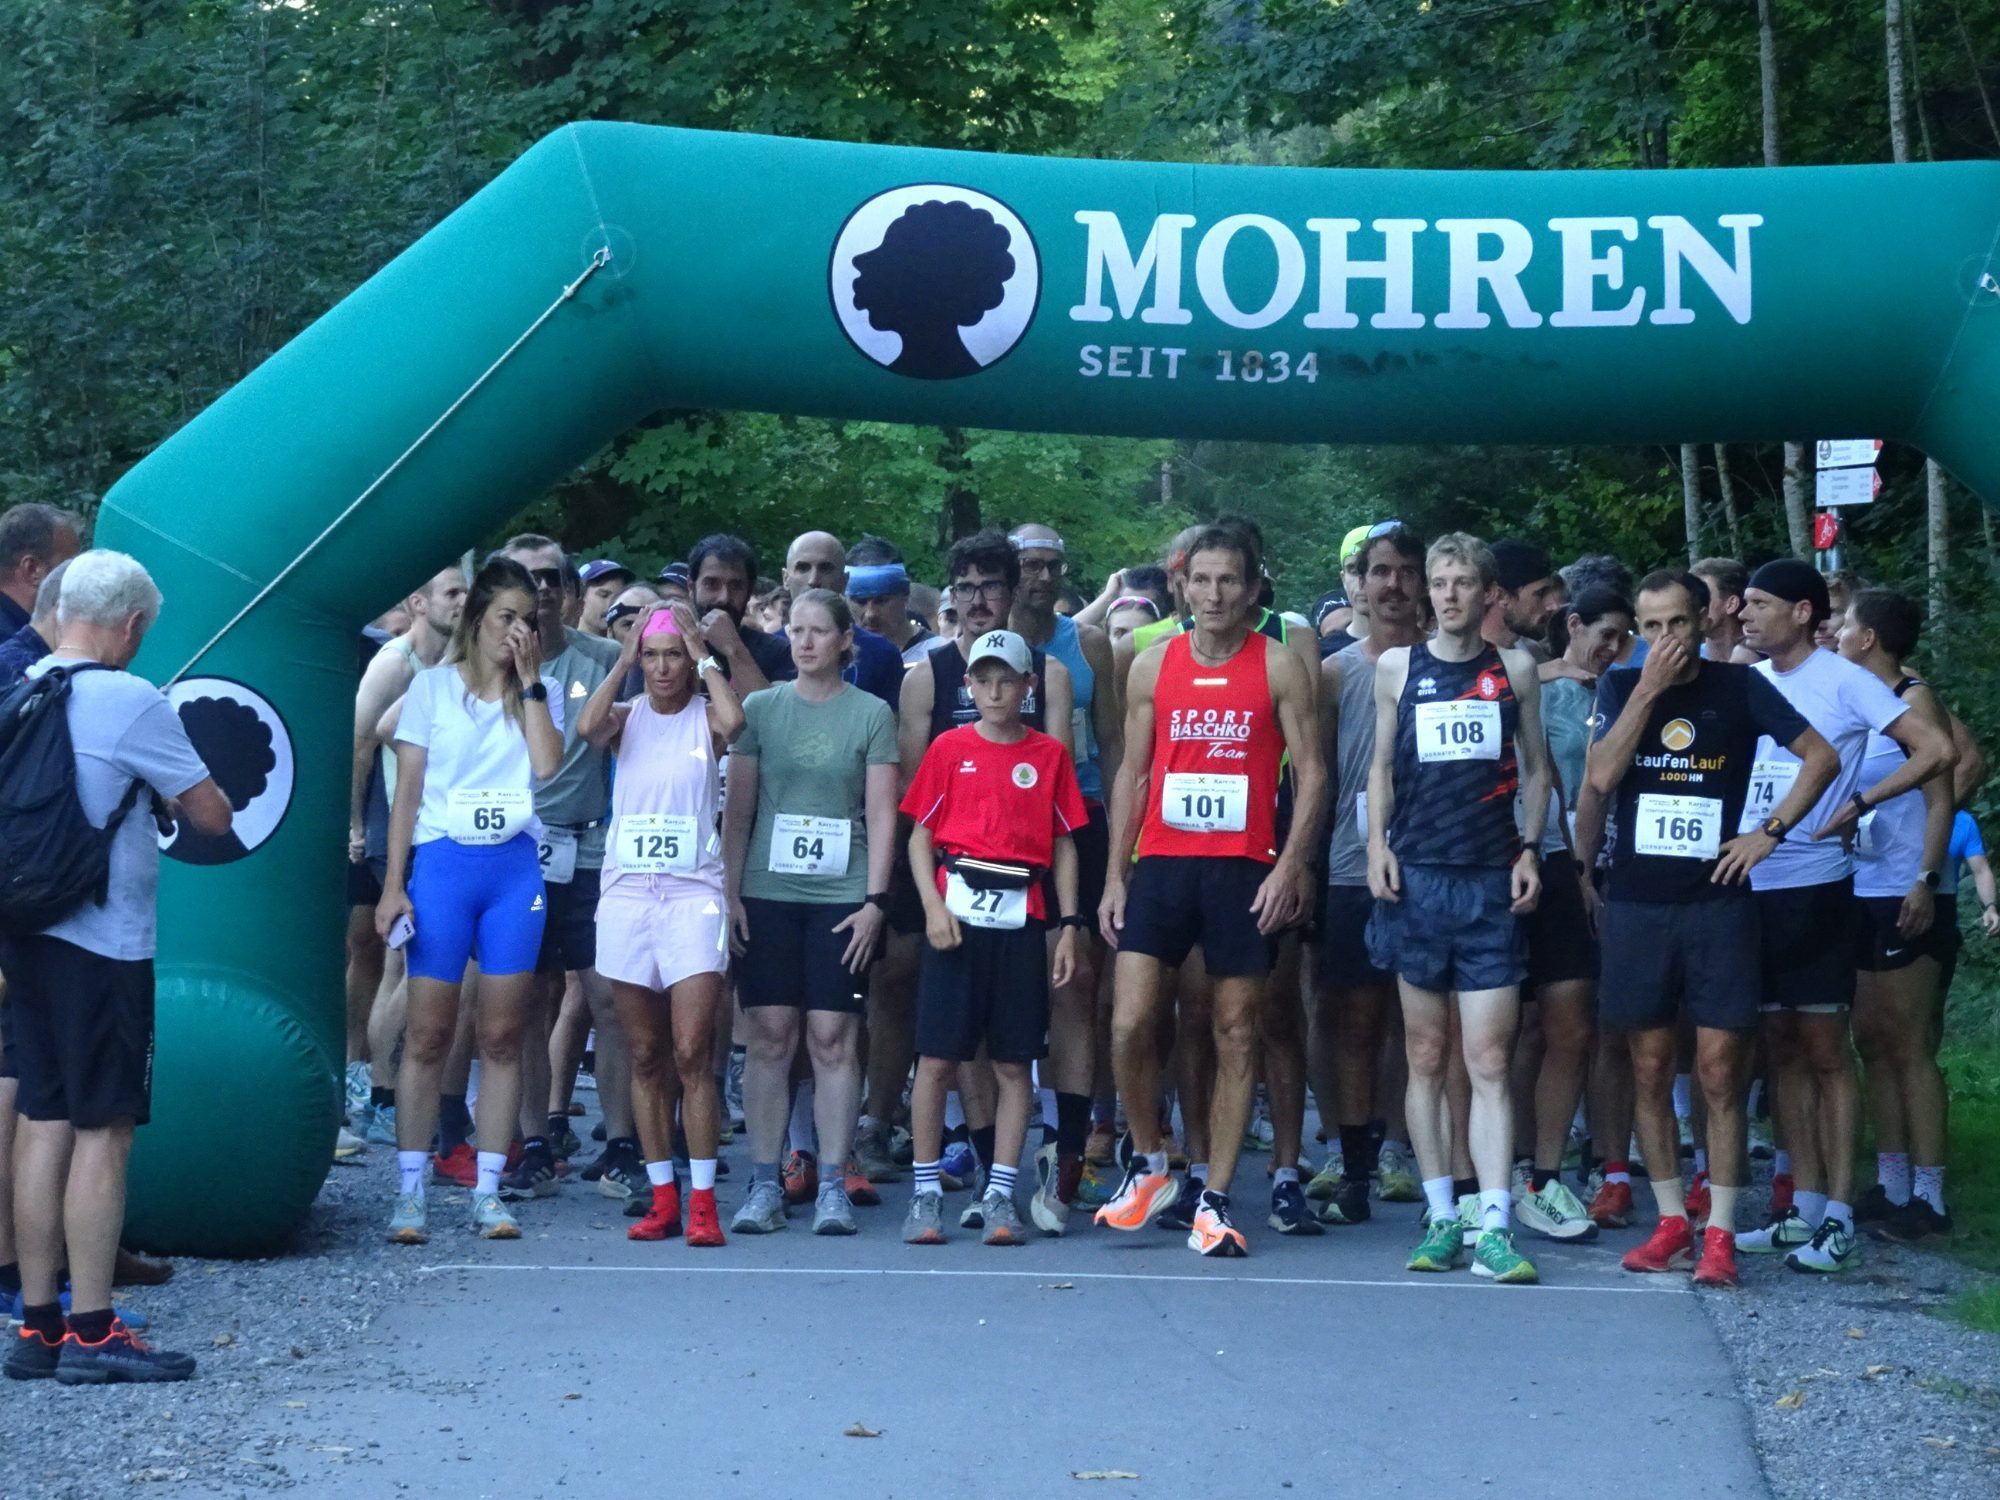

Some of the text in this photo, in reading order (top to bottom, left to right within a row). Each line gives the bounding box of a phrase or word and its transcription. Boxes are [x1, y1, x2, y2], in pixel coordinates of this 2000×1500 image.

[1069, 210, 1764, 329] MOHREN
[1079, 344, 1320, 383] SEIT 1834
[1171, 709, 1254, 724] SPORT
[1170, 723, 1251, 738] HASCHKO
[1435, 720, 1485, 746] 108
[1206, 741, 1248, 760] Team
[1635, 753, 1726, 770] taufenLauf
[1660, 772, 1688, 782] 1000
[1754, 781, 1774, 804] 74
[1181, 794, 1226, 819] 101
[474, 807, 506, 830] 65
[1655, 816, 1703, 841] 166
[633, 835, 679, 858] 125
[793, 836, 824, 860] 64
[970, 889, 1004, 912] 27
